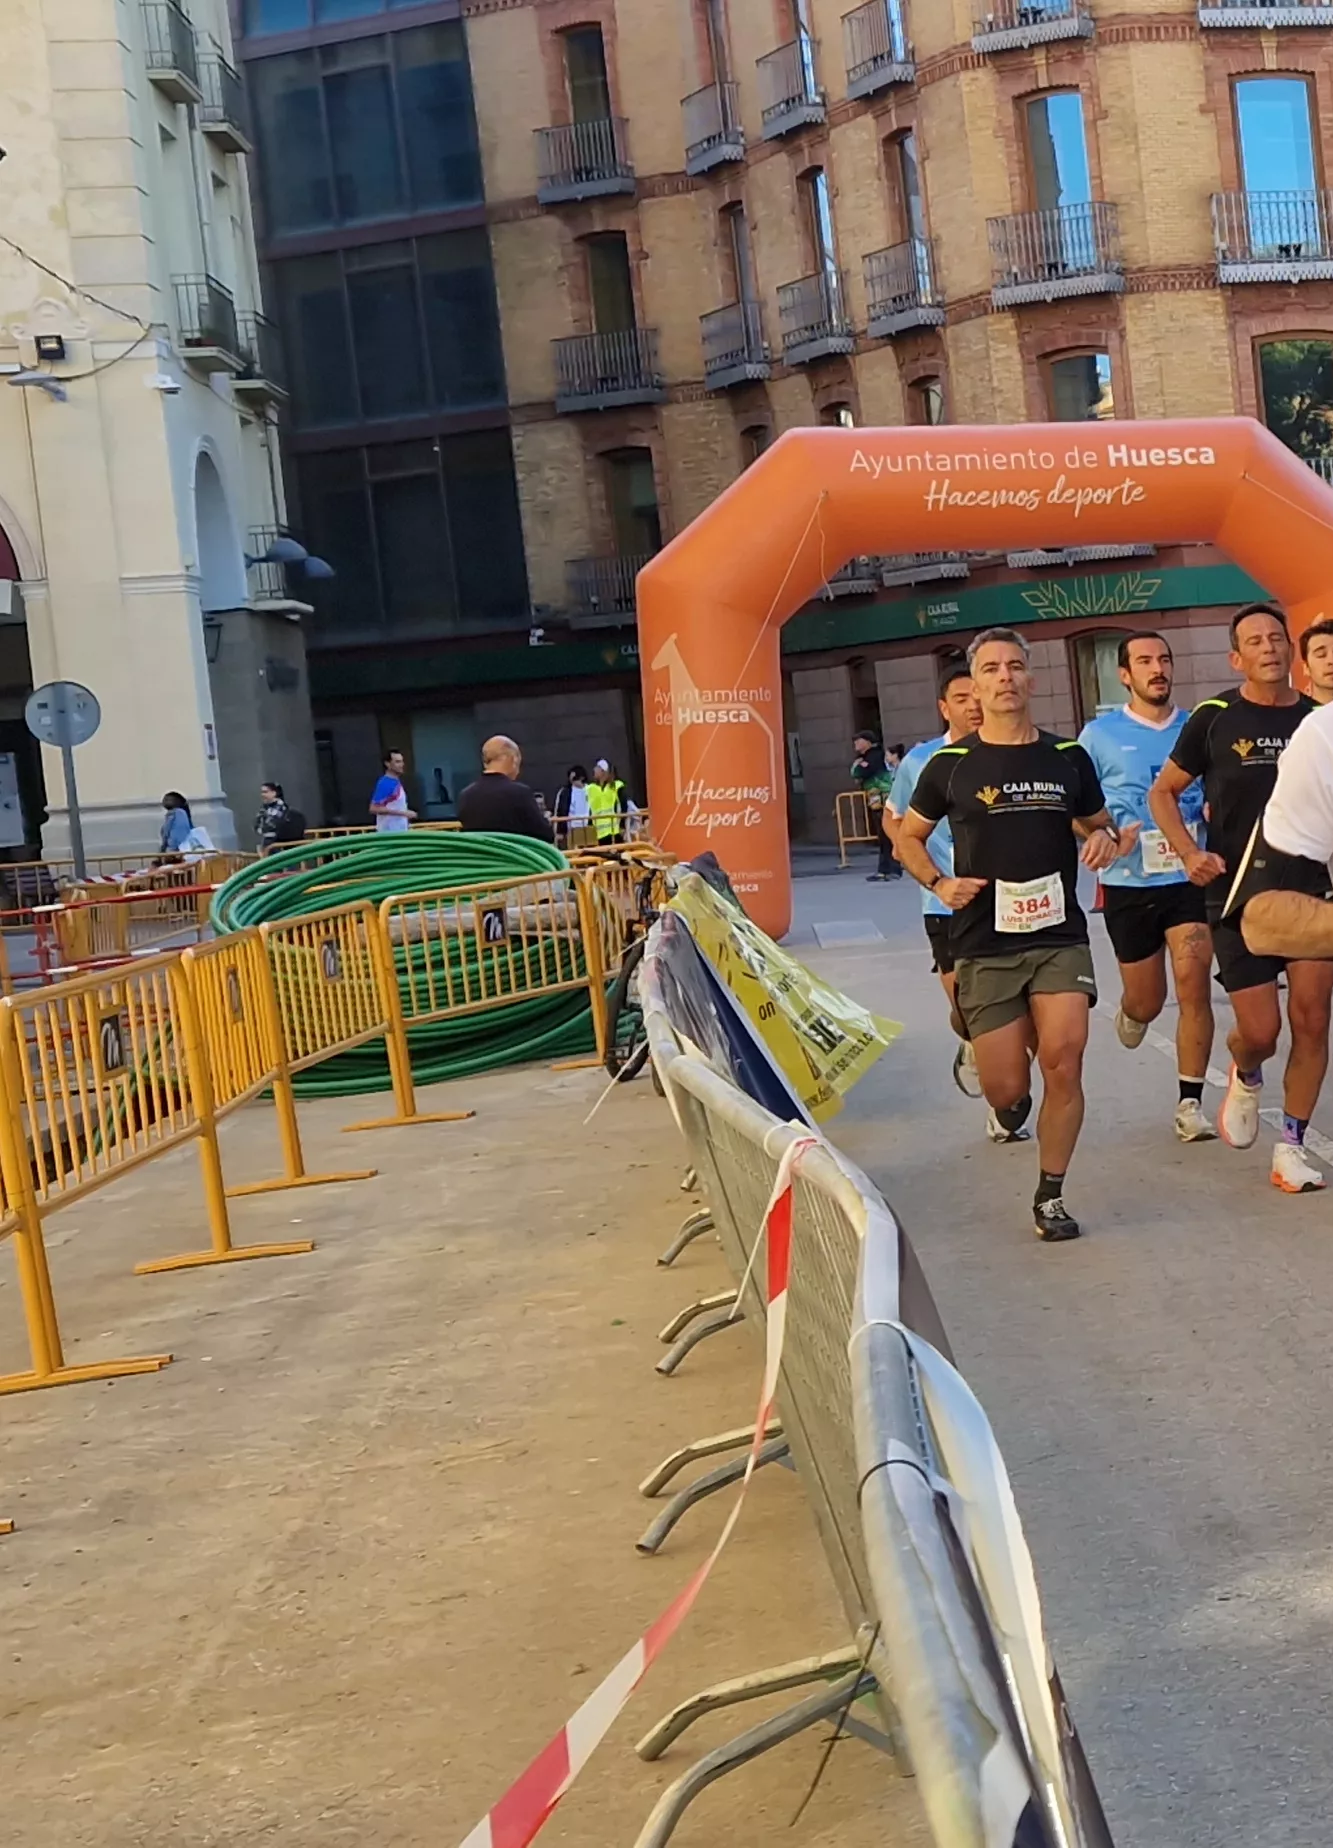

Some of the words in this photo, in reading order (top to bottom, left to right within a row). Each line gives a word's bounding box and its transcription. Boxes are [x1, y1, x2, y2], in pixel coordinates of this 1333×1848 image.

[850, 448, 1055, 479] Ayuntamiento
[1064, 446, 1099, 470] de
[1108, 444, 1215, 467] Huesca
[923, 478, 1040, 512] Hacemos
[1047, 474, 1146, 518] deporte
[654, 686, 772, 705] Ayuntamiento
[655, 708, 673, 725] de
[677, 706, 750, 724] Huesca
[1256, 737, 1284, 748] CAJA
[683, 779, 772, 805] Hacemos
[1002, 781, 1031, 794] CAJA
[1033, 781, 1067, 795] RURAL
[685, 802, 762, 838] deporte
[1012, 894, 1051, 915] 384
